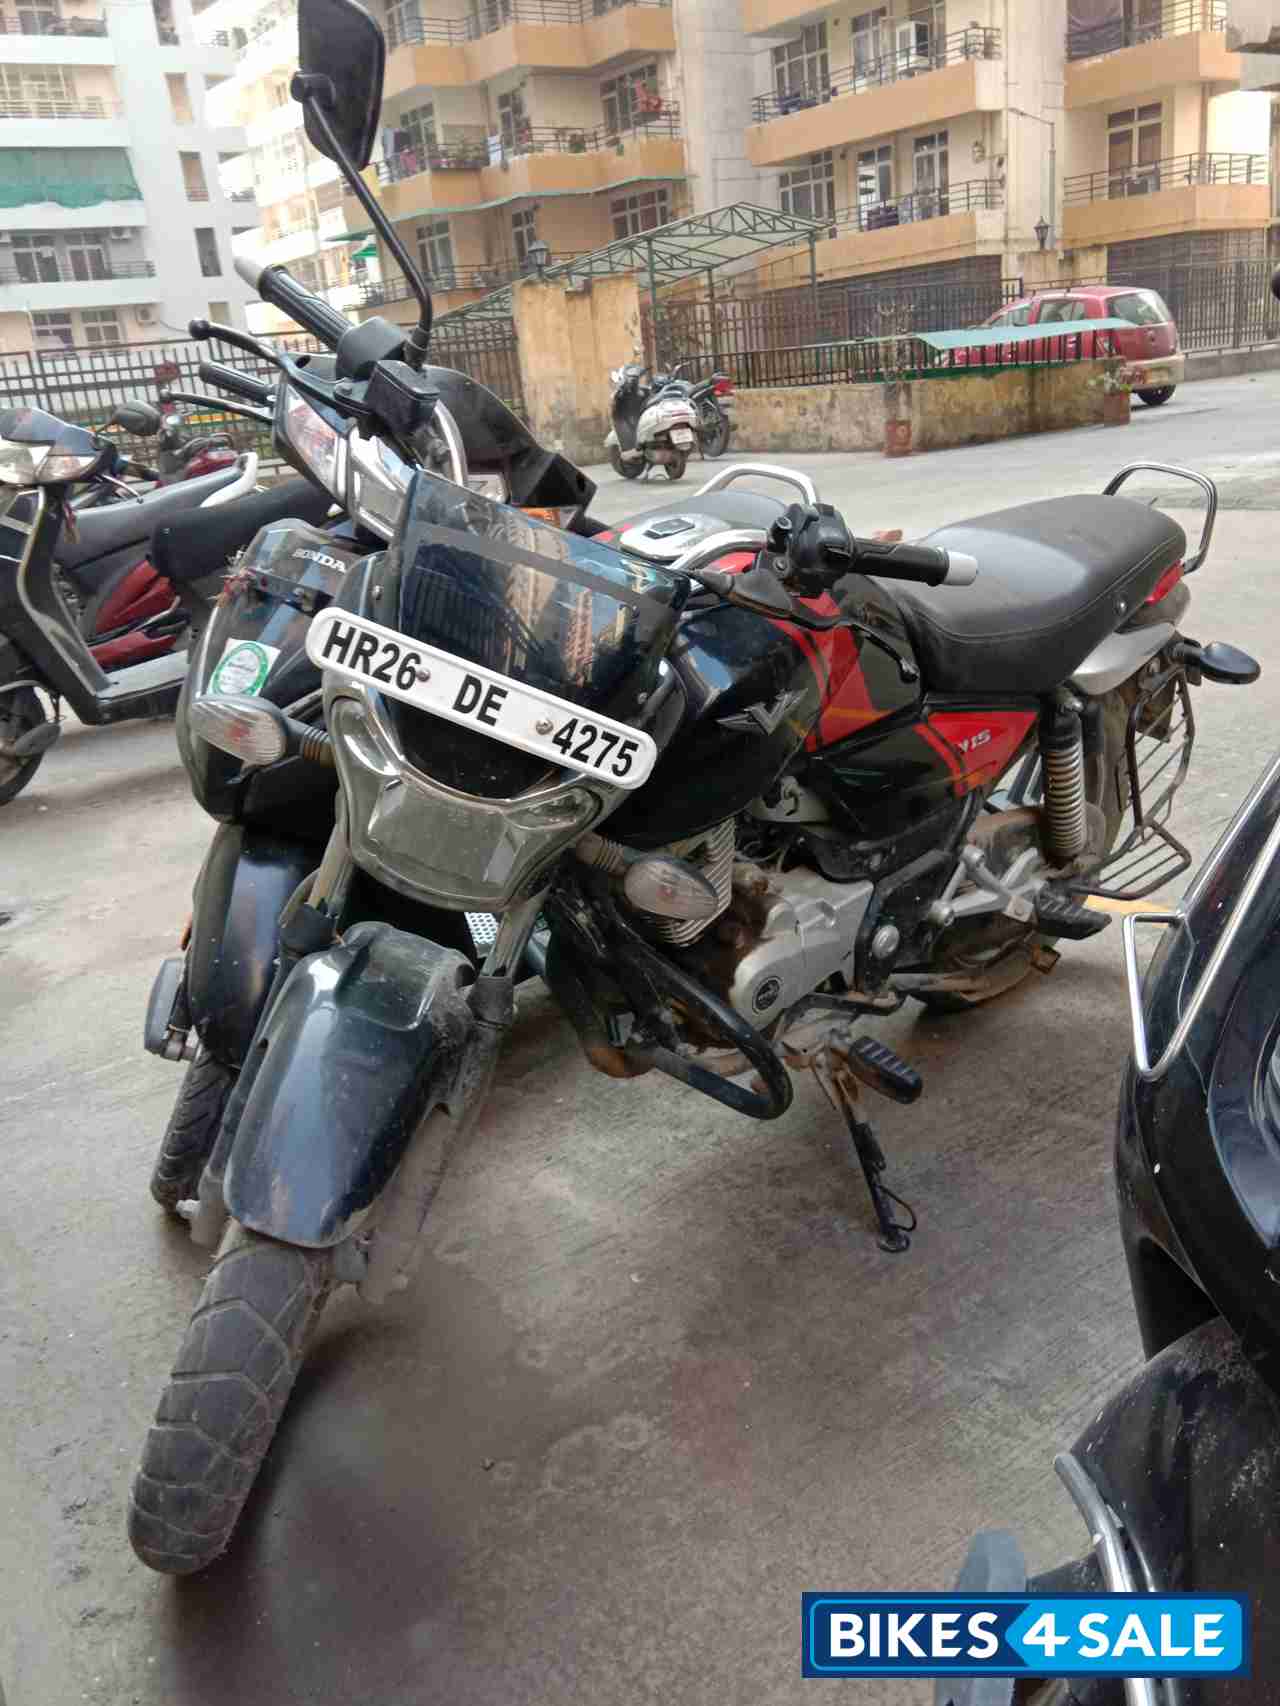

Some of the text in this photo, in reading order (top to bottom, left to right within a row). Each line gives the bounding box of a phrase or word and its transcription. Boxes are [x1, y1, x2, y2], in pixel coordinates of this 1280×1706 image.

[321, 621, 421, 690] HR26
[452, 674, 508, 726] DE
[552, 718, 638, 777] 4275
